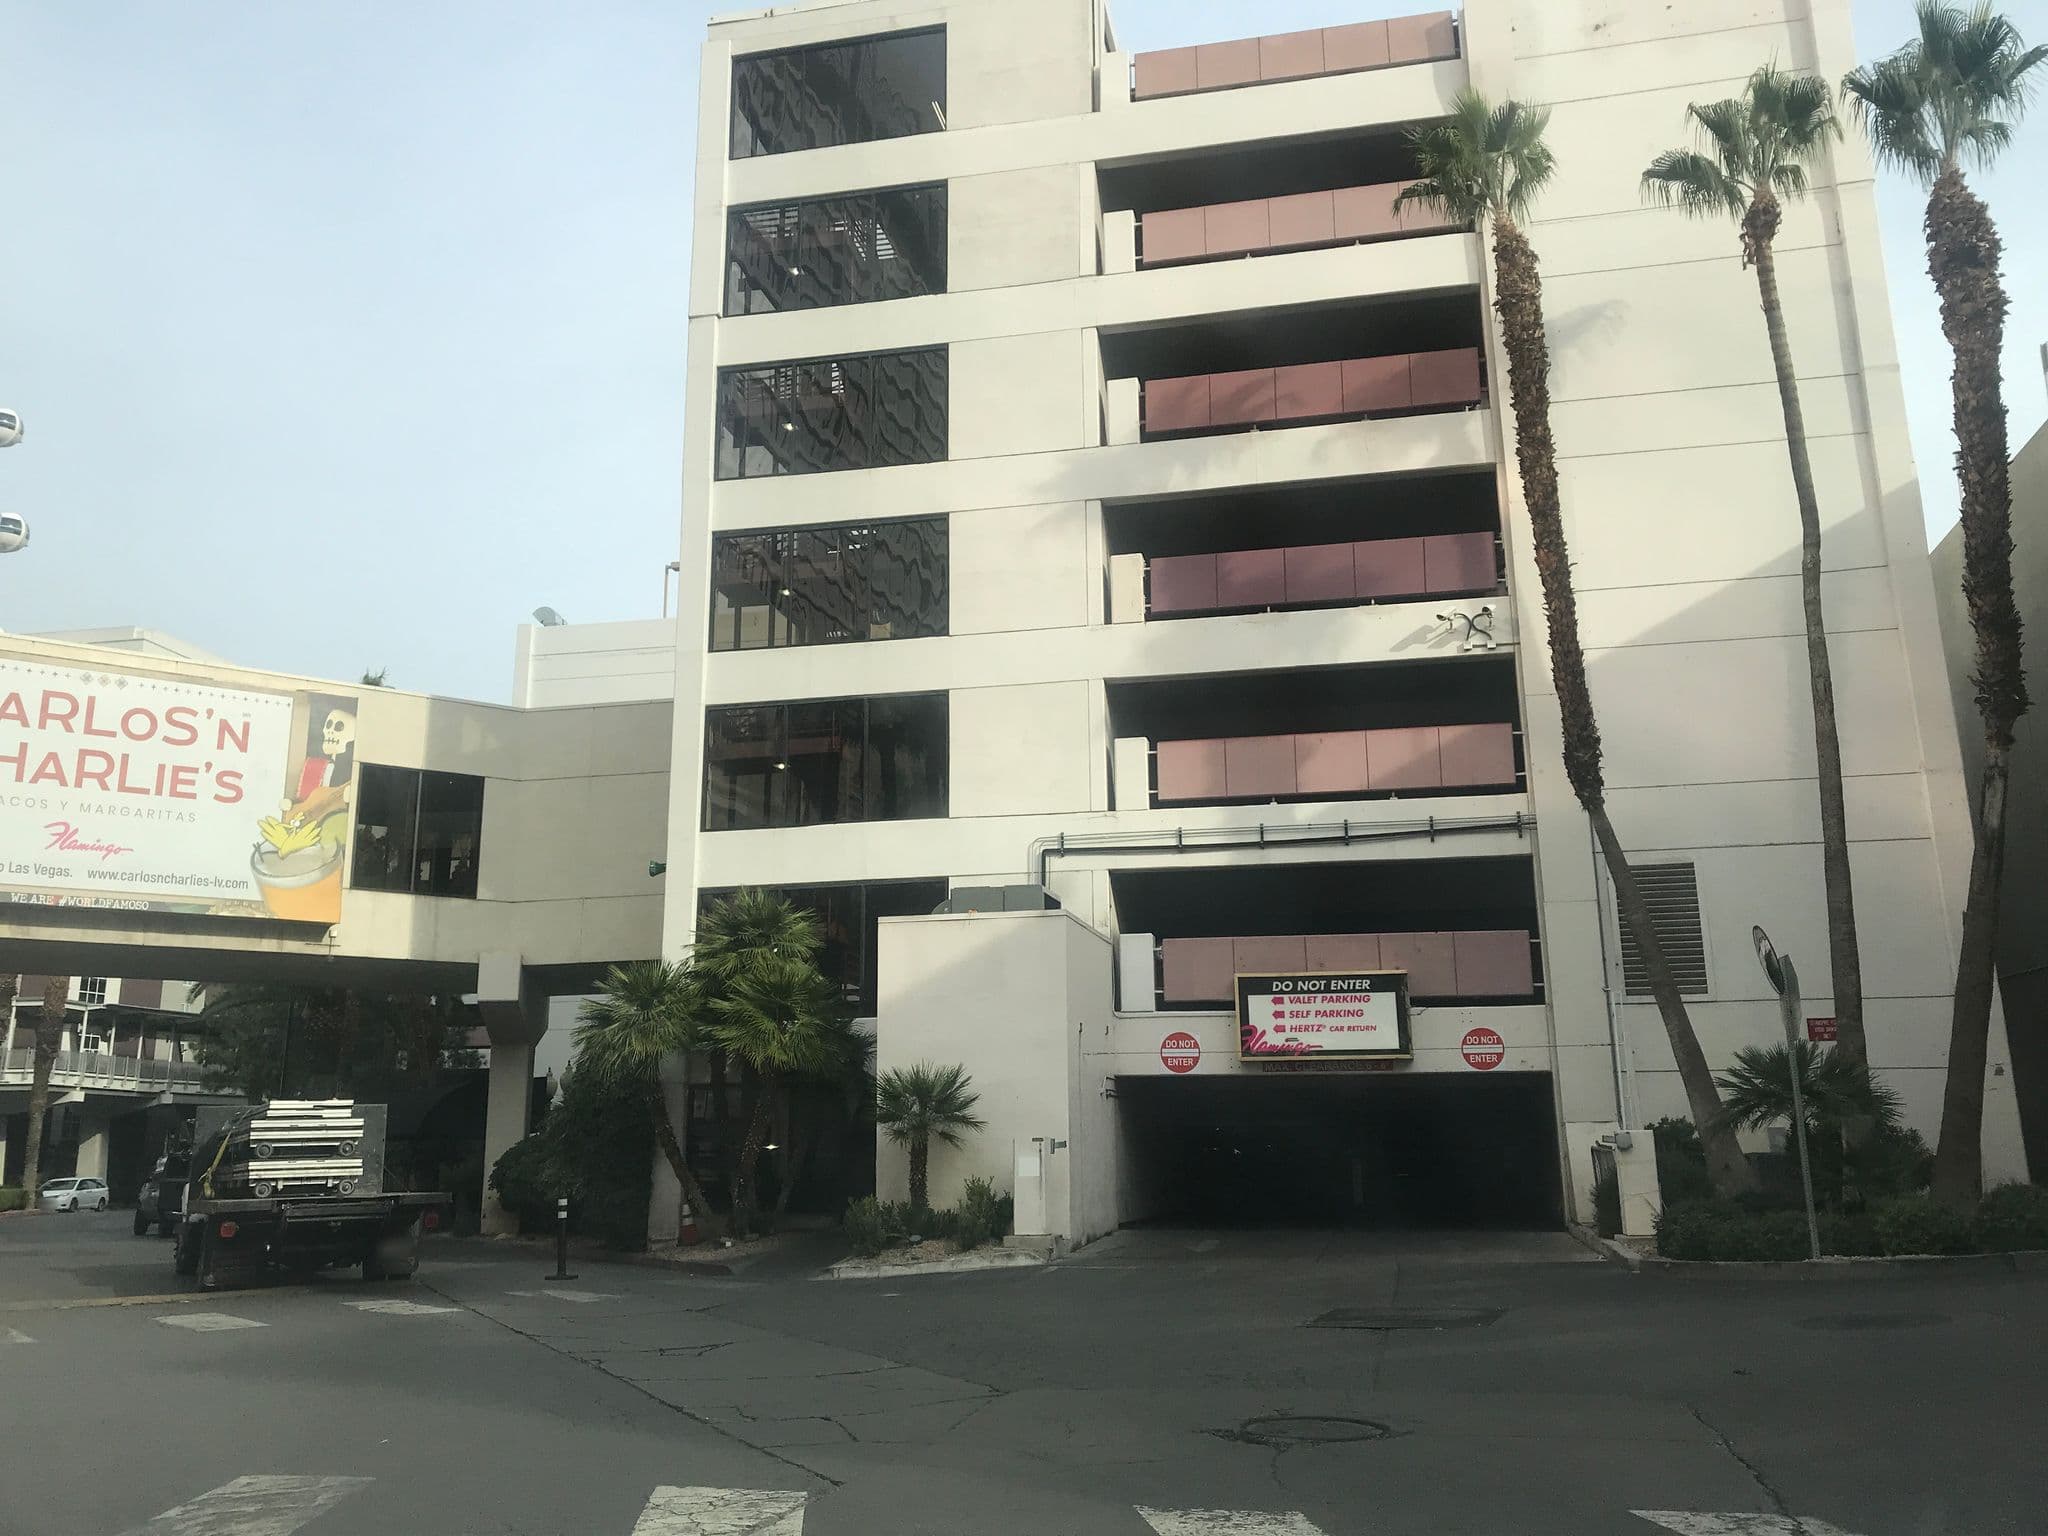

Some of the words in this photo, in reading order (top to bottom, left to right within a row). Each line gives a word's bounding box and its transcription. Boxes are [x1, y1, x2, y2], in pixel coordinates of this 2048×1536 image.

[60, 800, 69, 811] Y
[79, 803, 197, 823] MARGARITAS
[43, 821, 134, 861] Flamingo
[8, 861, 30, 875] Las
[33, 863, 73, 878] Vegas.
[87, 868, 249, 890] www.carlosncharlies-lv.com
[11, 892, 28, 903] WE
[29, 894, 54, 905] ARE
[1272, 981, 1293, 992] DO
[1297, 980, 1327, 991] NOT
[1330, 979, 1371, 990] ENTER
[1288, 995, 1318, 1005] VALET
[1321, 994, 1371, 1004] PARKING
[1289, 1010, 1312, 1019] SELF
[1314, 1009, 1364, 1019] PARKING
[1165, 1039, 1178, 1048] DO
[1179, 1039, 1196, 1048] NOT
[1240, 1024, 1324, 1056] Flamingo
[1466, 1036, 1479, 1045] DO
[1480, 1035, 1498, 1044] NOT
[1167, 1057, 1194, 1066] ENTER
[1470, 1054, 1498, 1063] ENTER
